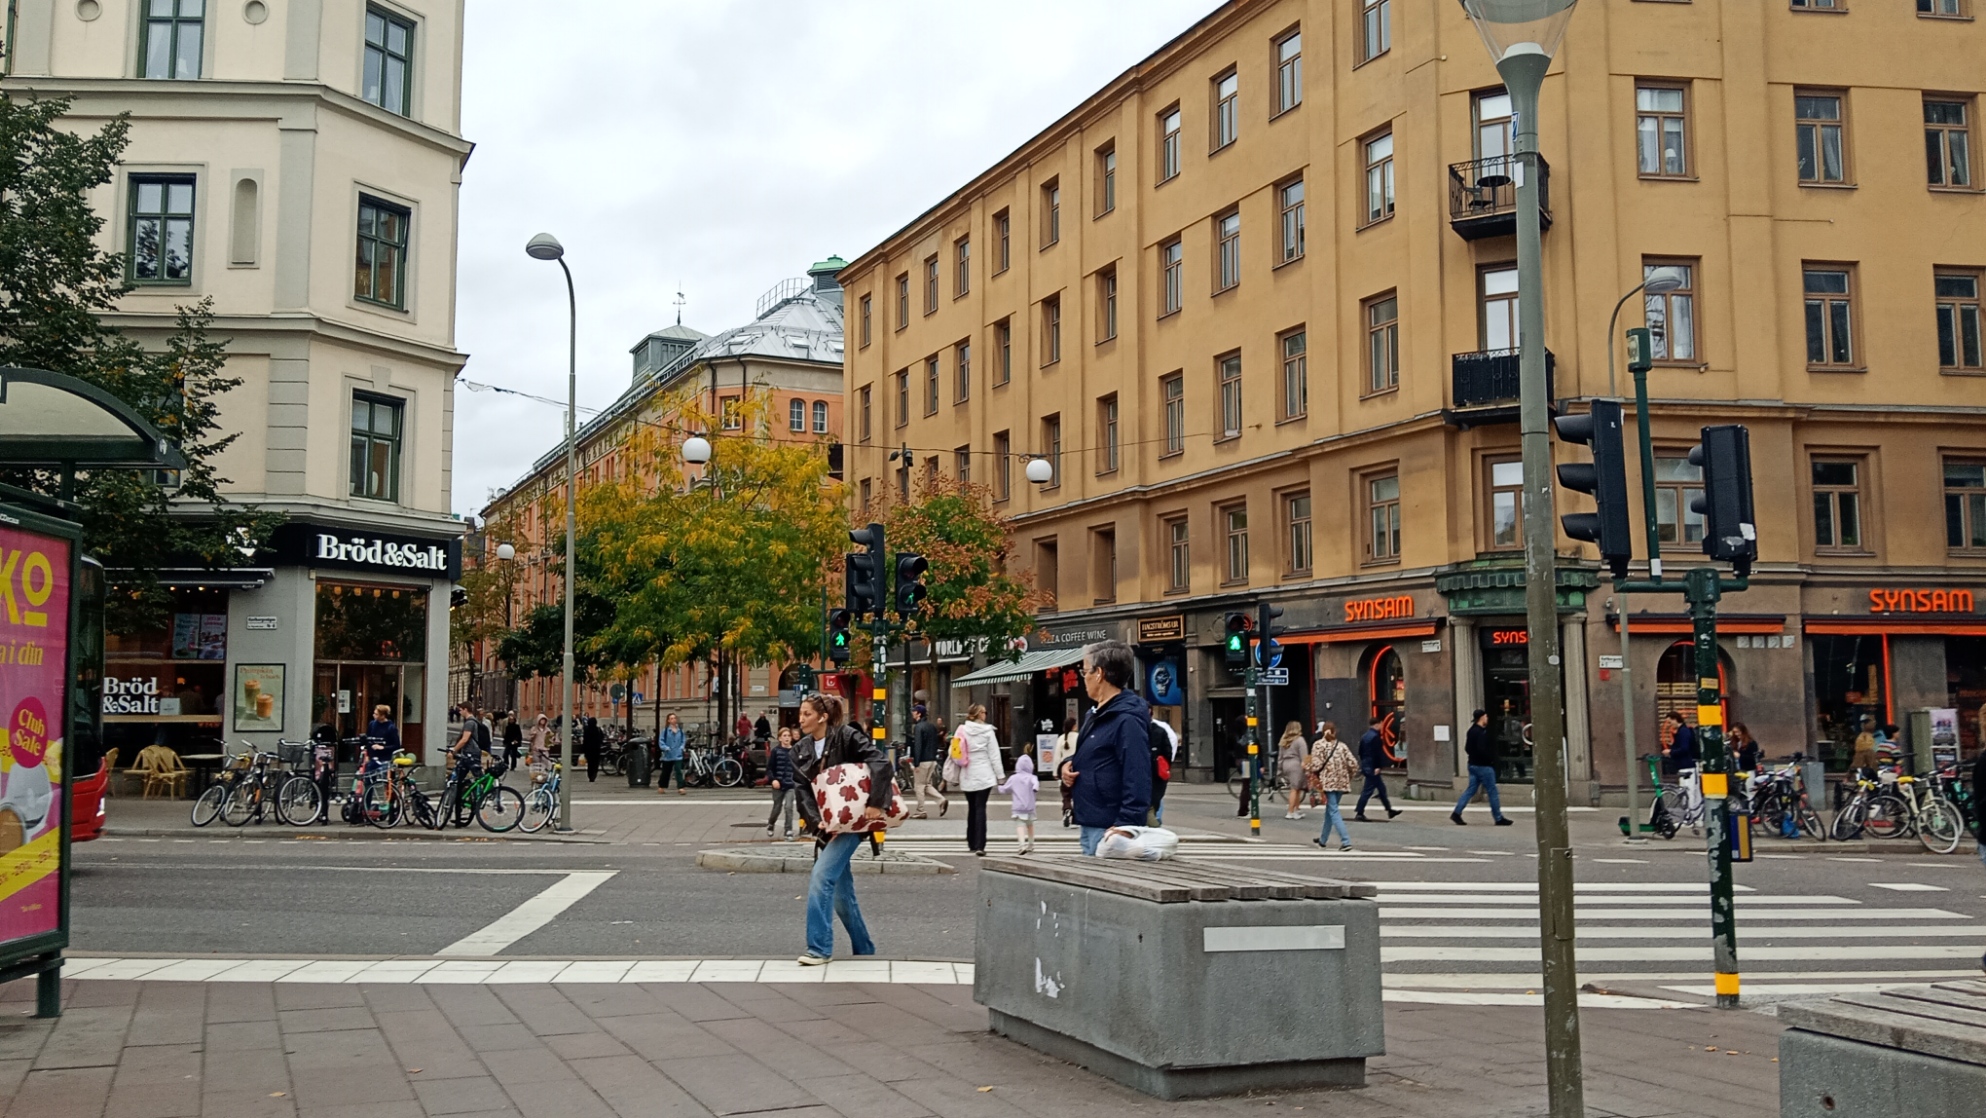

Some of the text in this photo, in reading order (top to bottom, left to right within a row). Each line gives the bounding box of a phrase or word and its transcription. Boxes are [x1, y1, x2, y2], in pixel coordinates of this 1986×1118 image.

[316, 534, 447, 570] Bröd&Salt
[1344, 595, 1414, 622] SYNSAM
[1869, 588, 1974, 612] SYNSAM
[1061, 631, 1085, 643] COFFEE
[1087, 629, 1107, 640] WINE
[1493, 631, 1527, 644] SYNS
[103, 677, 158, 695] Bröd
[103, 695, 159, 713] &Salt
[18, 708, 45, 738] Club
[13, 728, 42, 757] Sale
